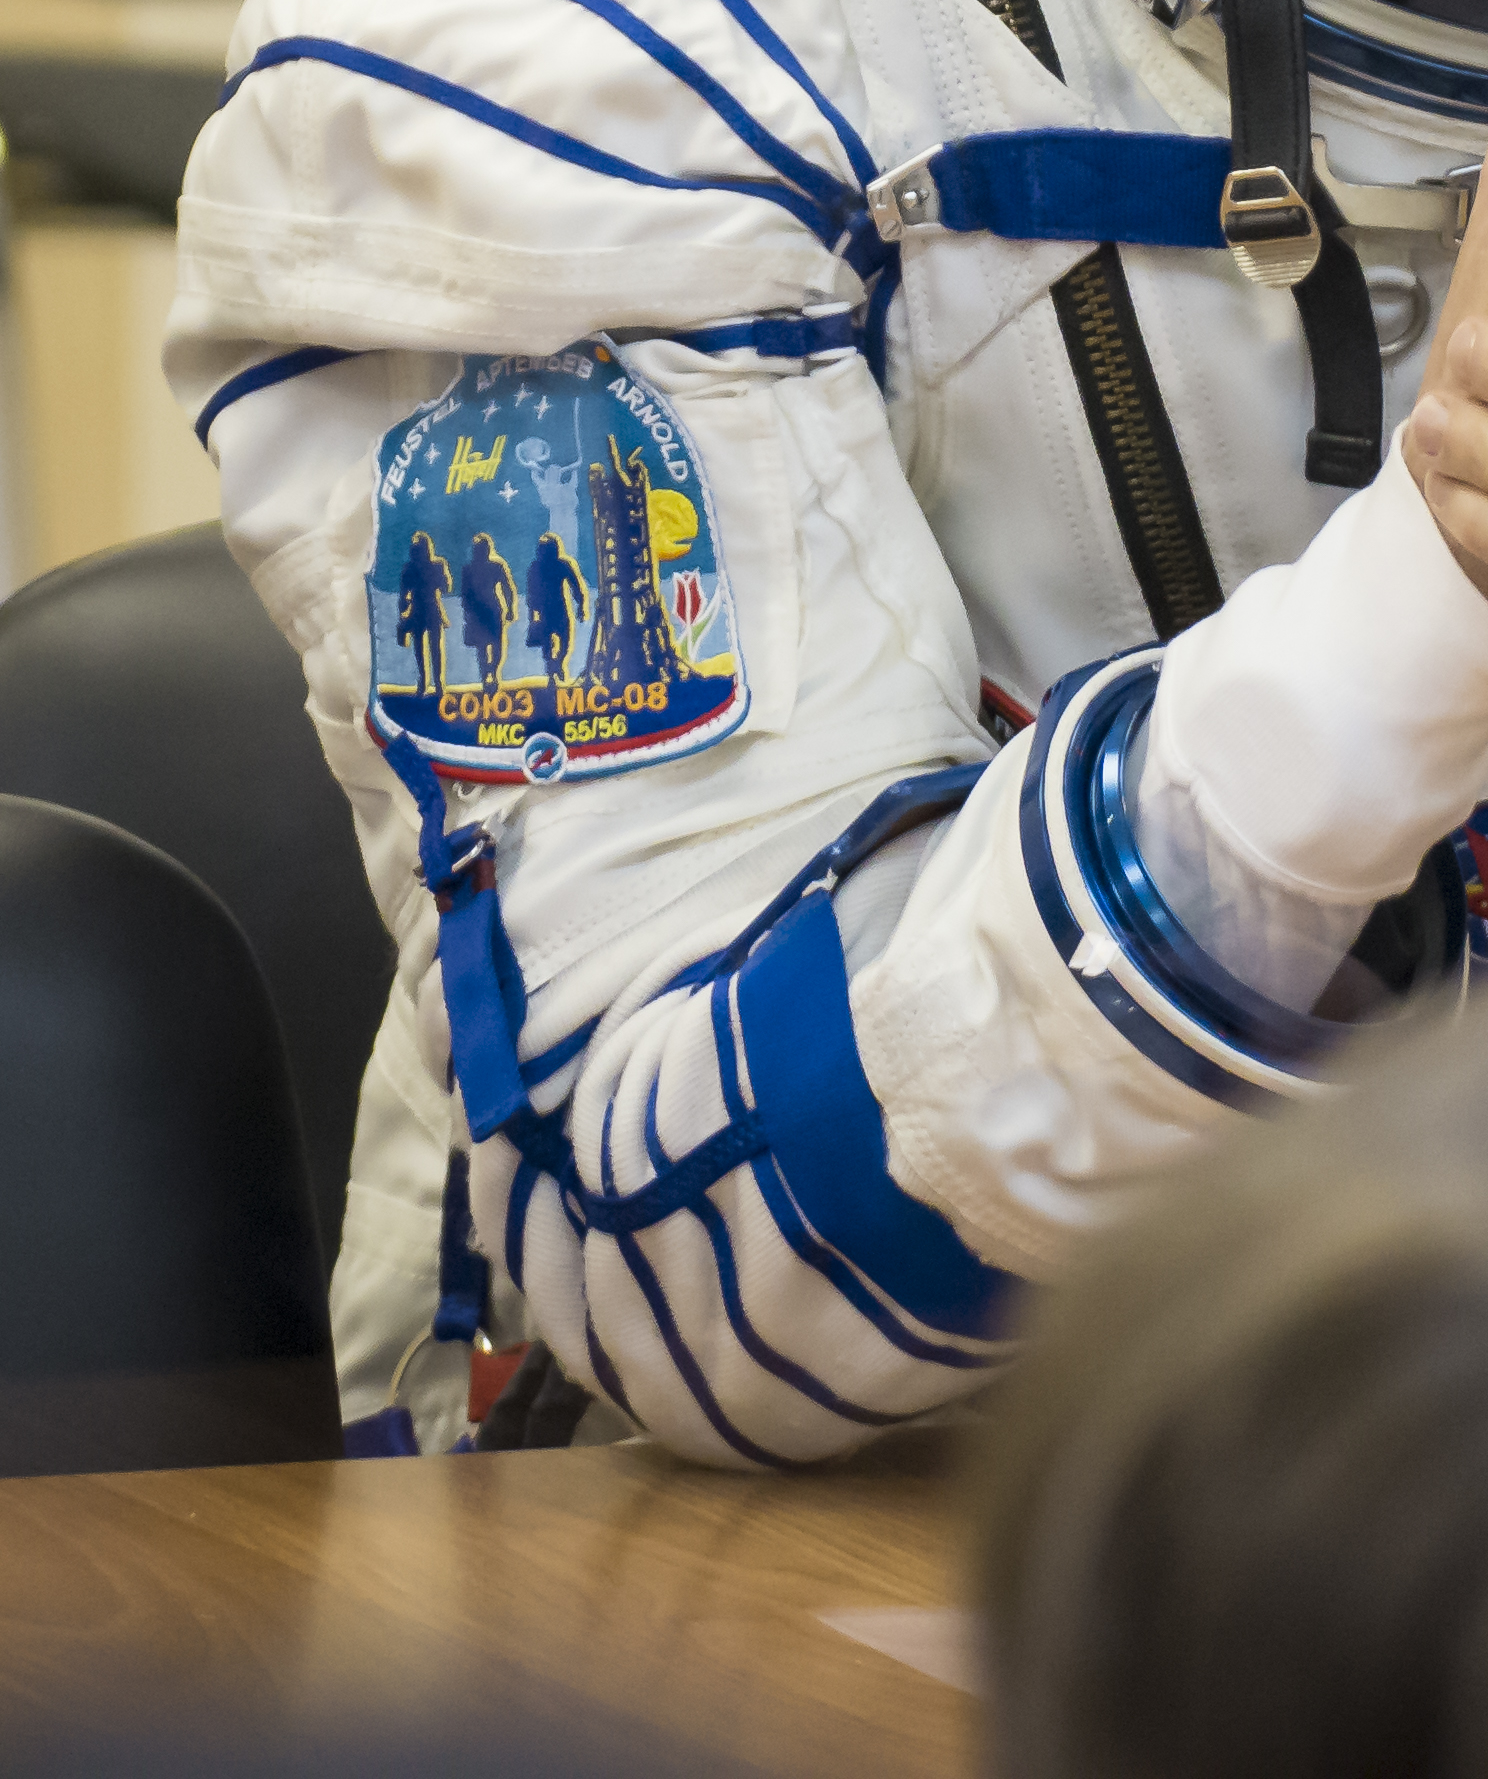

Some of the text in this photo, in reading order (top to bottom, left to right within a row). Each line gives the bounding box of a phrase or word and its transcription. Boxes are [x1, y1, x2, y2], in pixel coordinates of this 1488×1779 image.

[605, 377, 689, 483] ARNOLD
[438, 681, 668, 721] СОЮЗ МС-08
[478, 714, 627, 746] МКС 55/56
